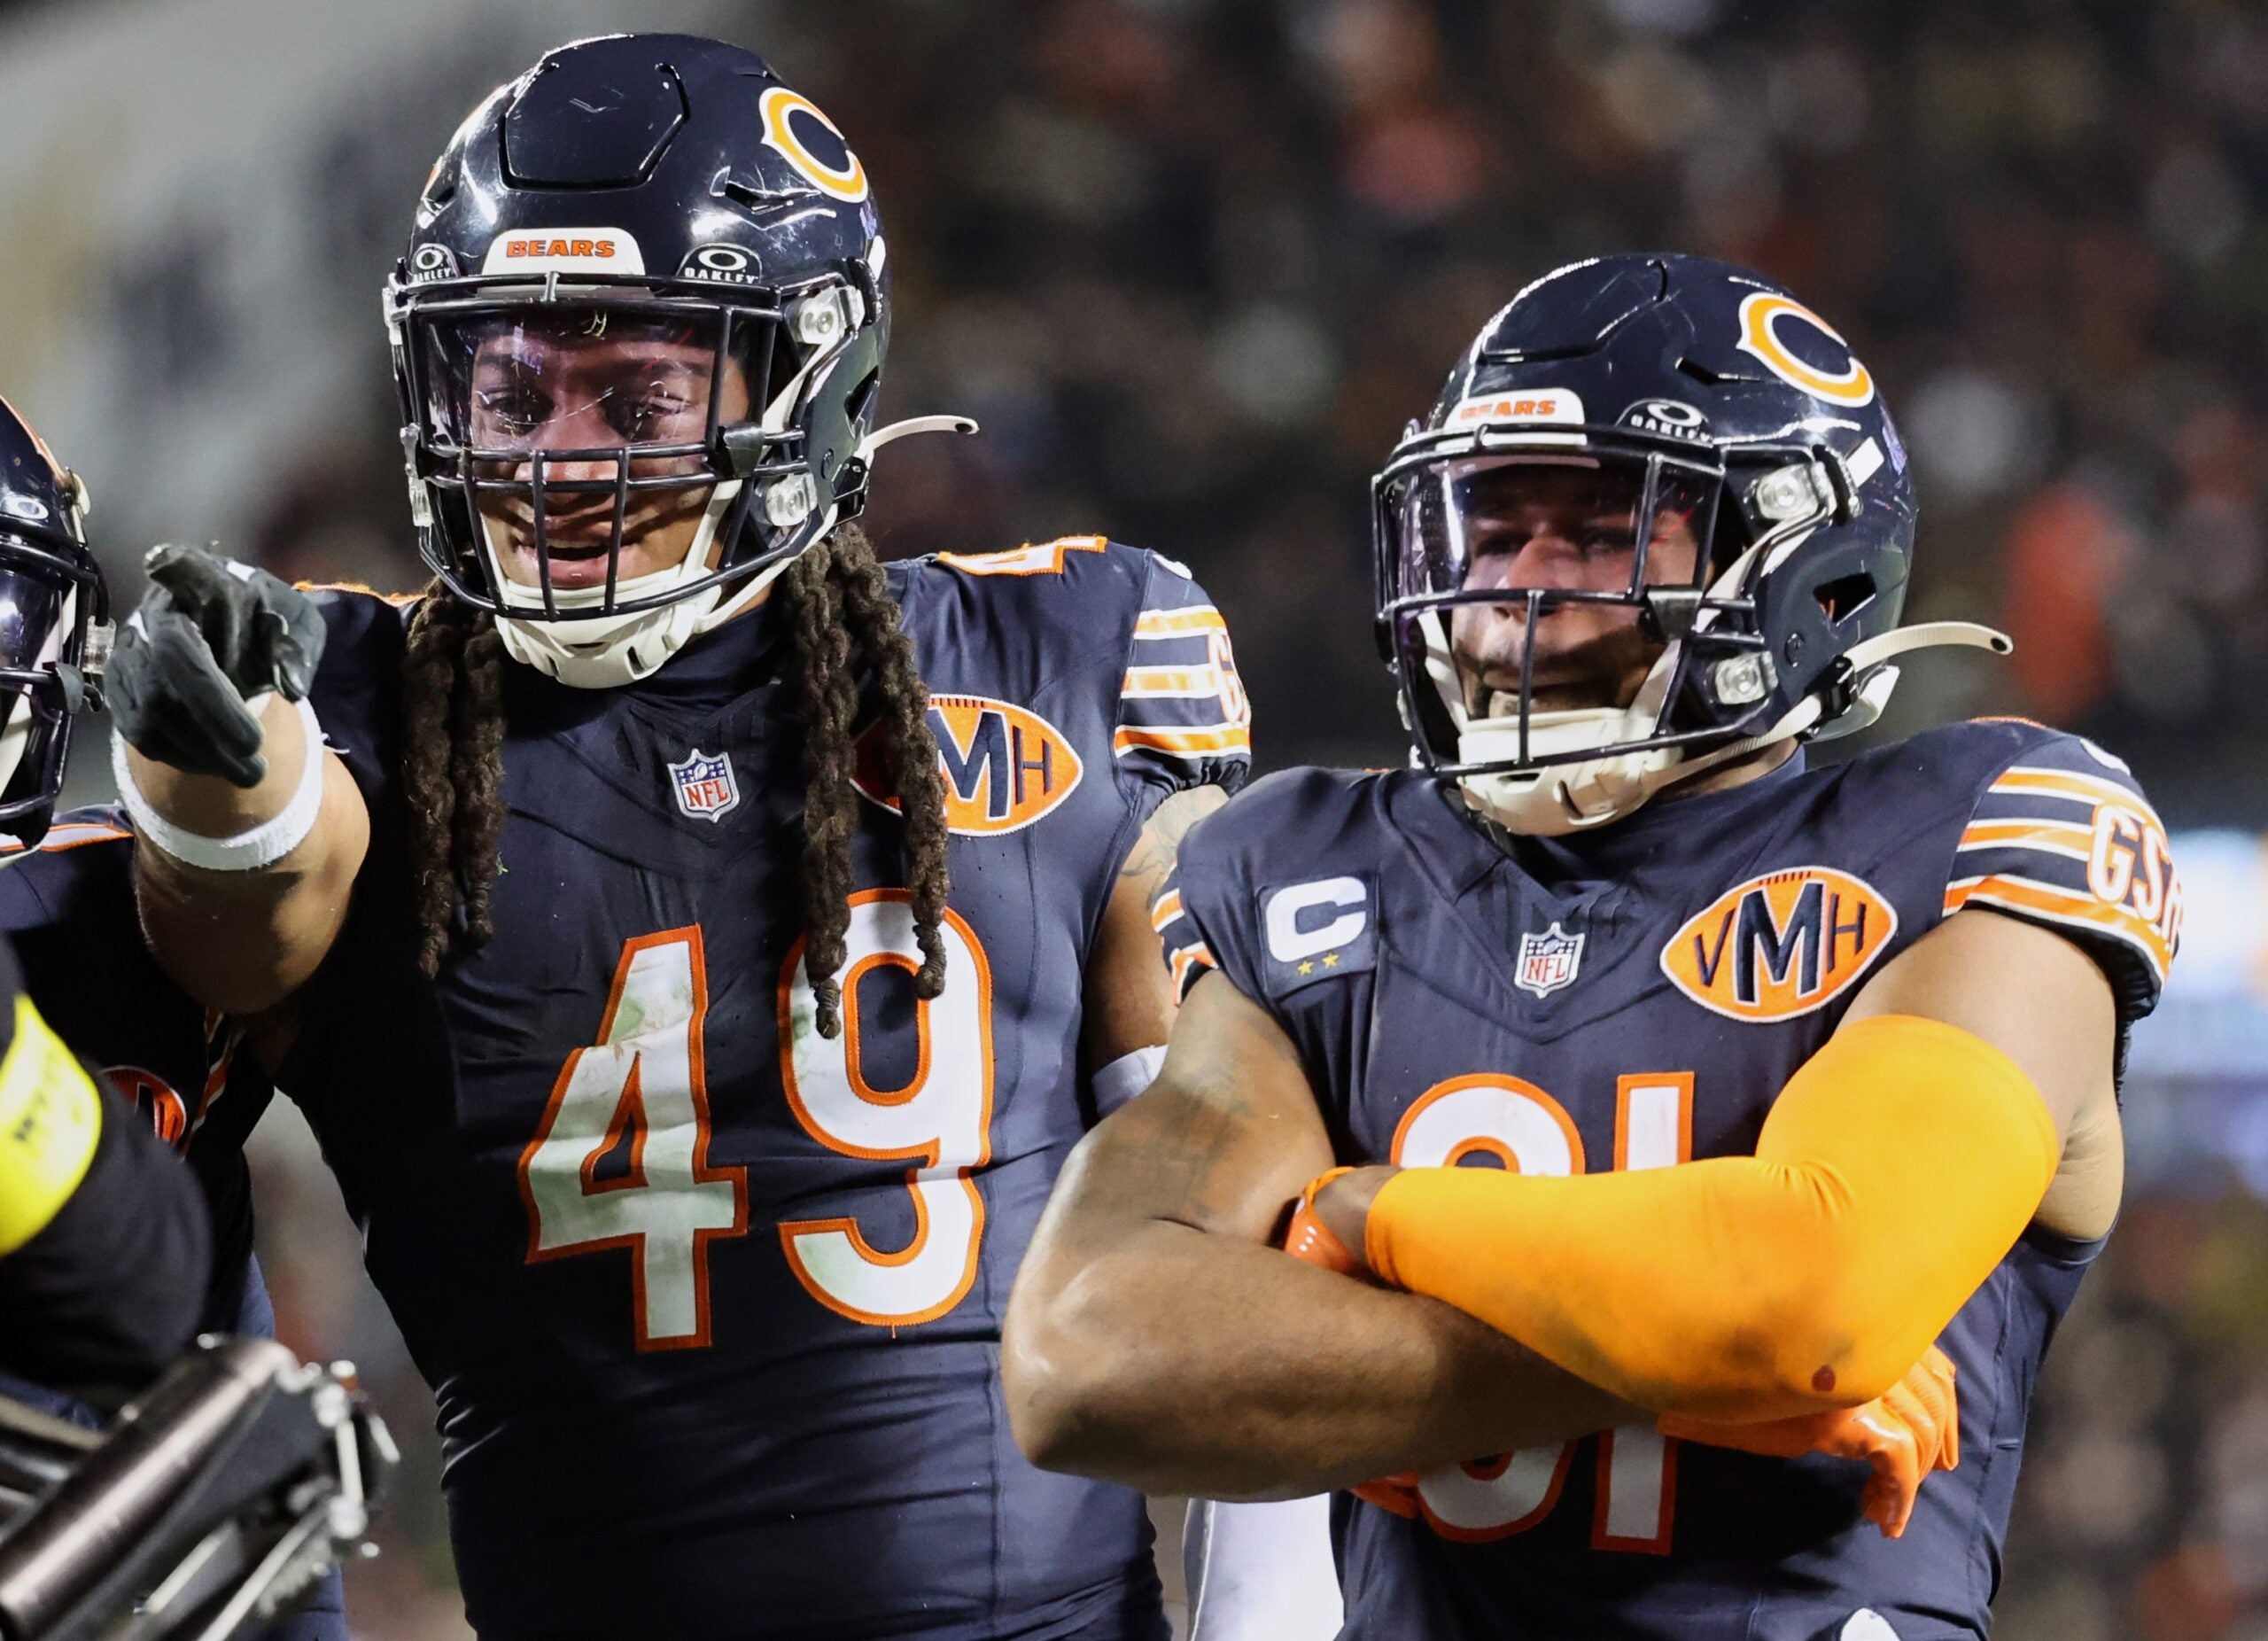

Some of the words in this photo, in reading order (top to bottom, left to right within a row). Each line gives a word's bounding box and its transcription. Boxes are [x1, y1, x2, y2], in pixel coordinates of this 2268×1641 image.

[758, 87, 868, 203] C
[506, 240, 615, 258] BEARS
[684, 267, 757, 284] OAKLEY
[1736, 292, 1875, 408] C
[685, 780, 728, 807] NFL
[925, 705, 1052, 822] MH
[1266, 875, 1367, 963] C
[1526, 957, 1565, 983] NFL
[1694, 879, 1868, 1007] VMH
[517, 888, 995, 1352] 49
